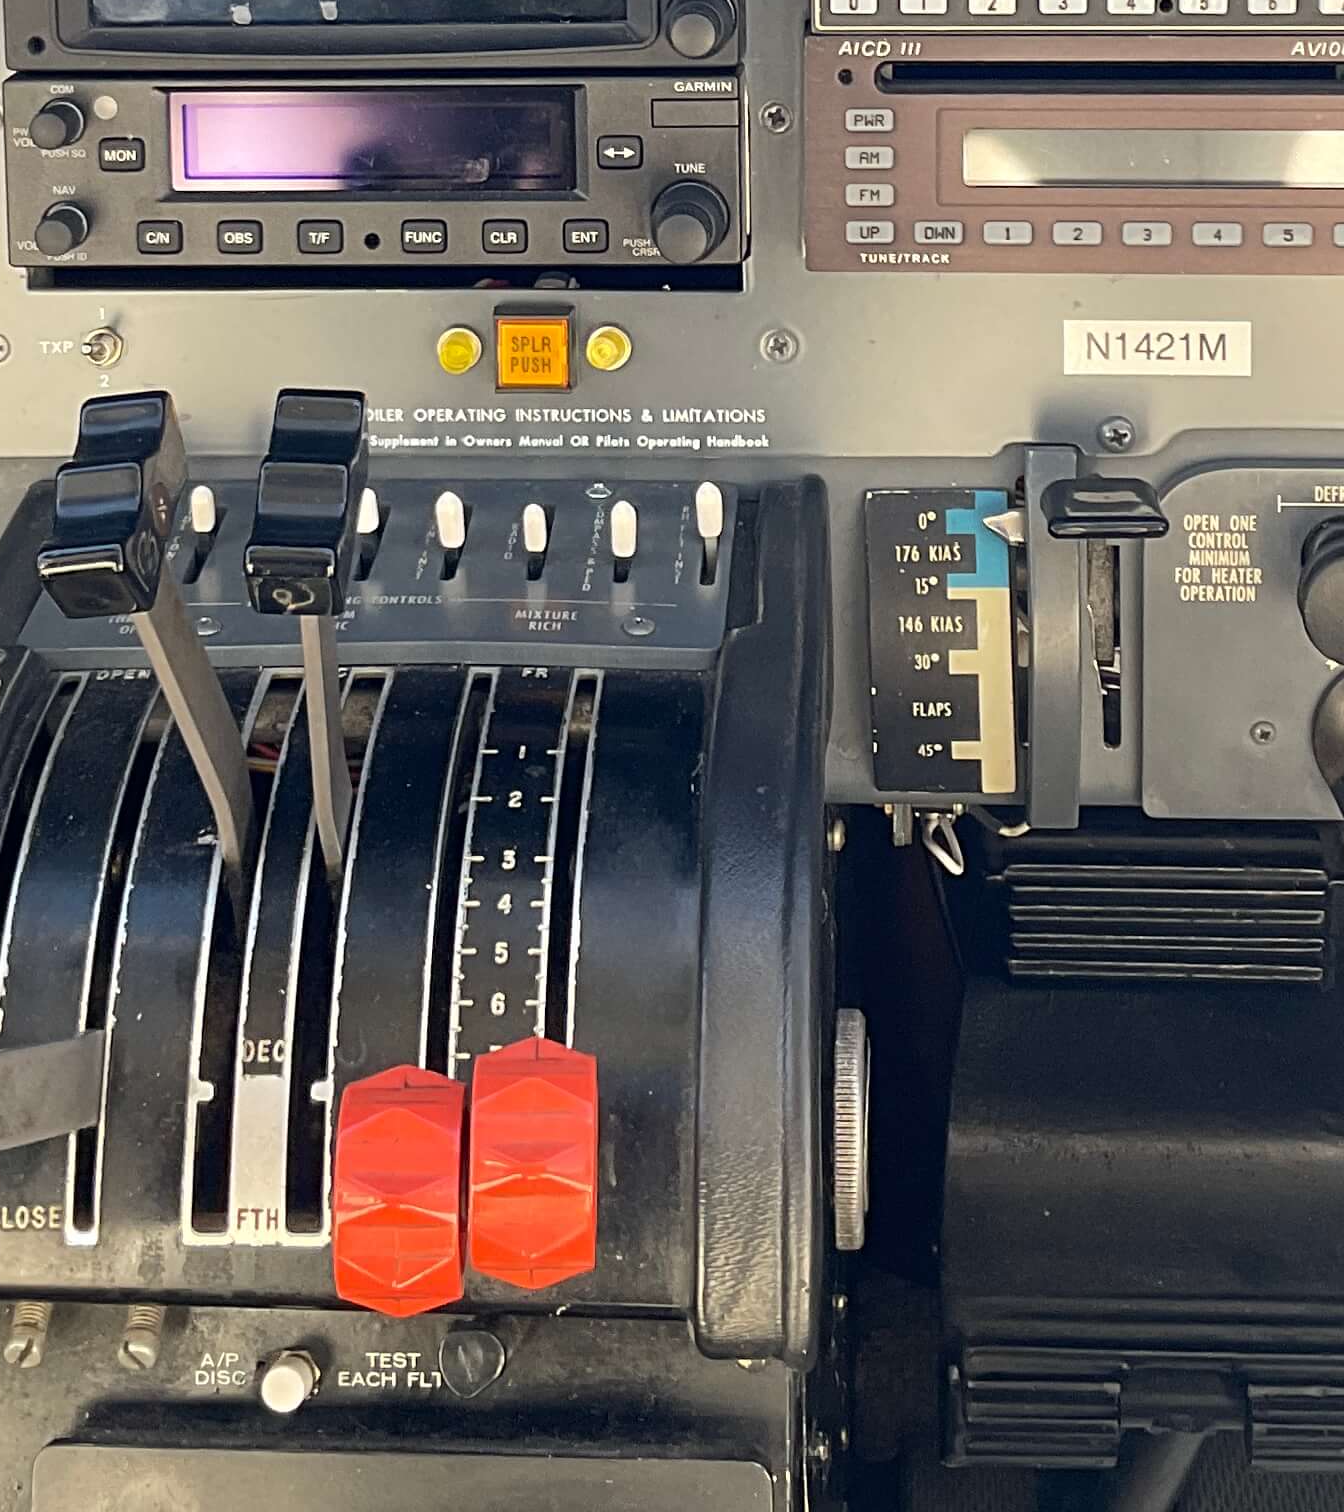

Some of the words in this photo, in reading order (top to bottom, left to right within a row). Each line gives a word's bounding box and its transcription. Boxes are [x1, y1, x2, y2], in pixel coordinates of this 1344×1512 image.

[839, 41, 891, 57] AICD
[900, 42, 921, 55] III
[674, 82, 732, 92] GARMIN
[105, 150, 136, 162] MON
[674, 164, 706, 174] TUNE
[405, 232, 442, 243] FUNC
[860, 252, 950, 264] TUNE/TRACK
[511, 336, 552, 353] SPLR
[1086, 332, 1227, 361] N1421M
[511, 356, 552, 374] PUSH
[413, 409, 506, 423] OPERATING
[515, 408, 632, 423] INSTRUCTIONS
[662, 408, 766, 423] LIMITATIONS
[1183, 515, 1222, 531] OPEN
[1230, 515, 1257, 531] ONE
[1189, 533, 1248, 548] CONTROL
[1189, 551, 1249, 565] MINIMUM
[1175, 568, 1200, 584] FOR
[1212, 568, 1262, 584] HEATER
[1181, 586, 1255, 601] OPERATION
[912, 702, 952, 717] FLAPS
[199, 1353, 239, 1370] A/P
[364, 1353, 421, 1370] TEST
[194, 1370, 247, 1386] DISC
[338, 1372, 399, 1389] EACH
